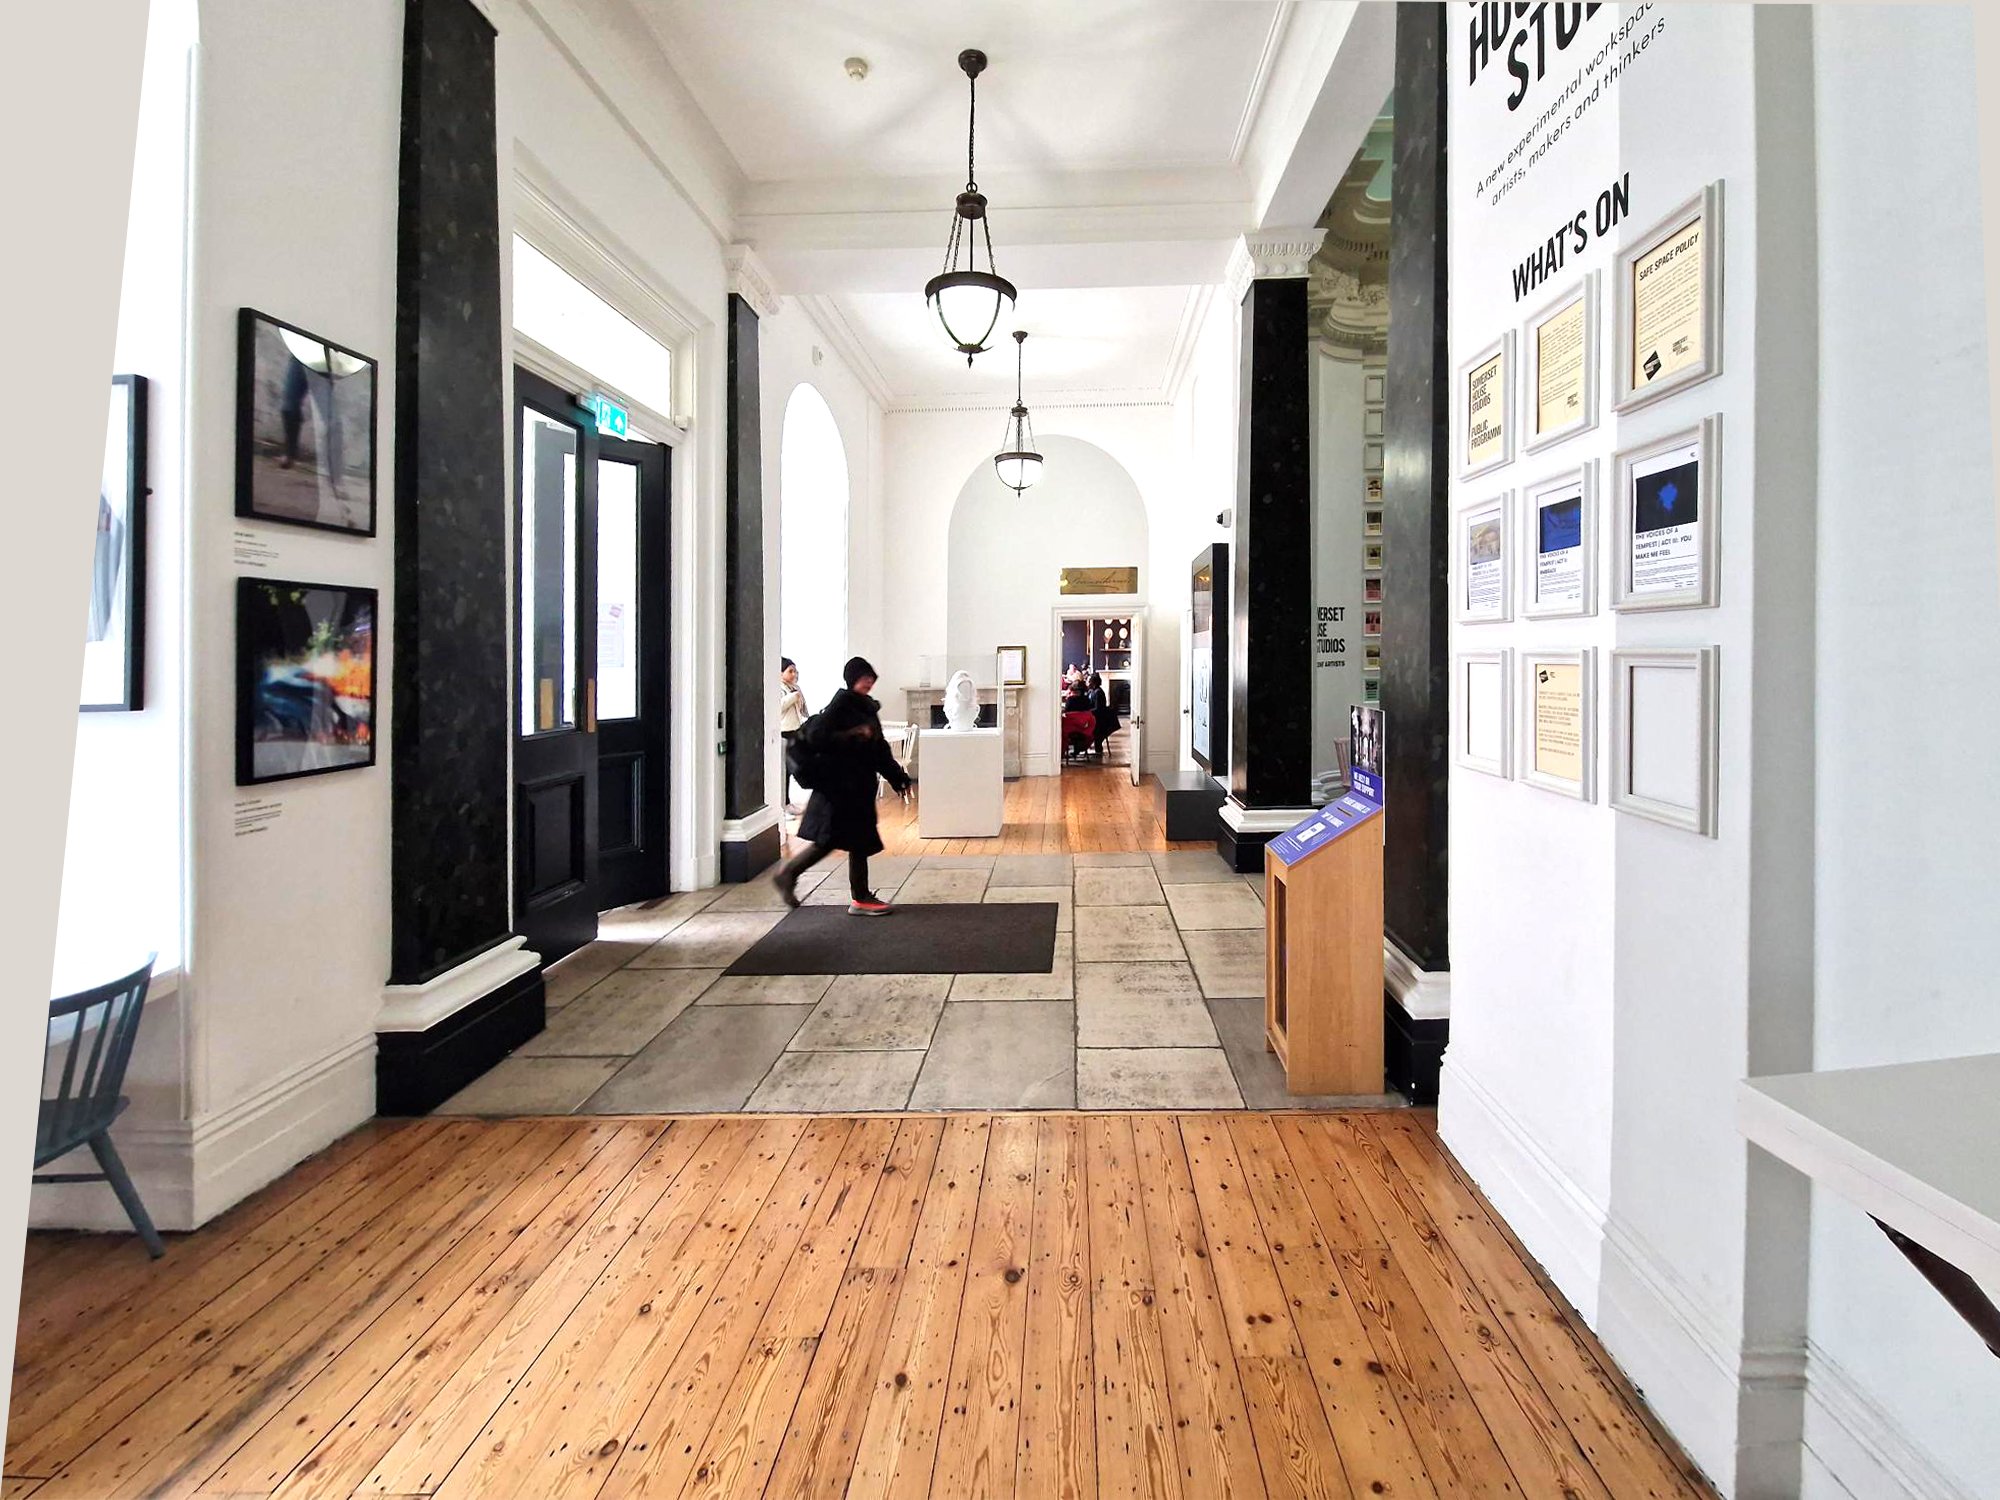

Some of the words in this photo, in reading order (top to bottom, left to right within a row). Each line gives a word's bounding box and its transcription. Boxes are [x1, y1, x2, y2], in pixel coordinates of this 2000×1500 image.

[1476, 181, 1484, 198] A
[1485, 162, 1506, 189] new
[1507, 69, 1582, 164] experimental
[1492, 170, 1527, 206] artists,
[1529, 113, 1572, 168] makers
[1574, 81, 1600, 120] and
[1604, 16, 1666, 89] thinkers
[1512, 210, 1588, 303] WHAT'S
[1596, 172, 1630, 238] ON
[1639, 264, 1654, 281] SAFE
[1654, 248, 1674, 273] SPACE
[1675, 232, 1699, 260] POLICY
